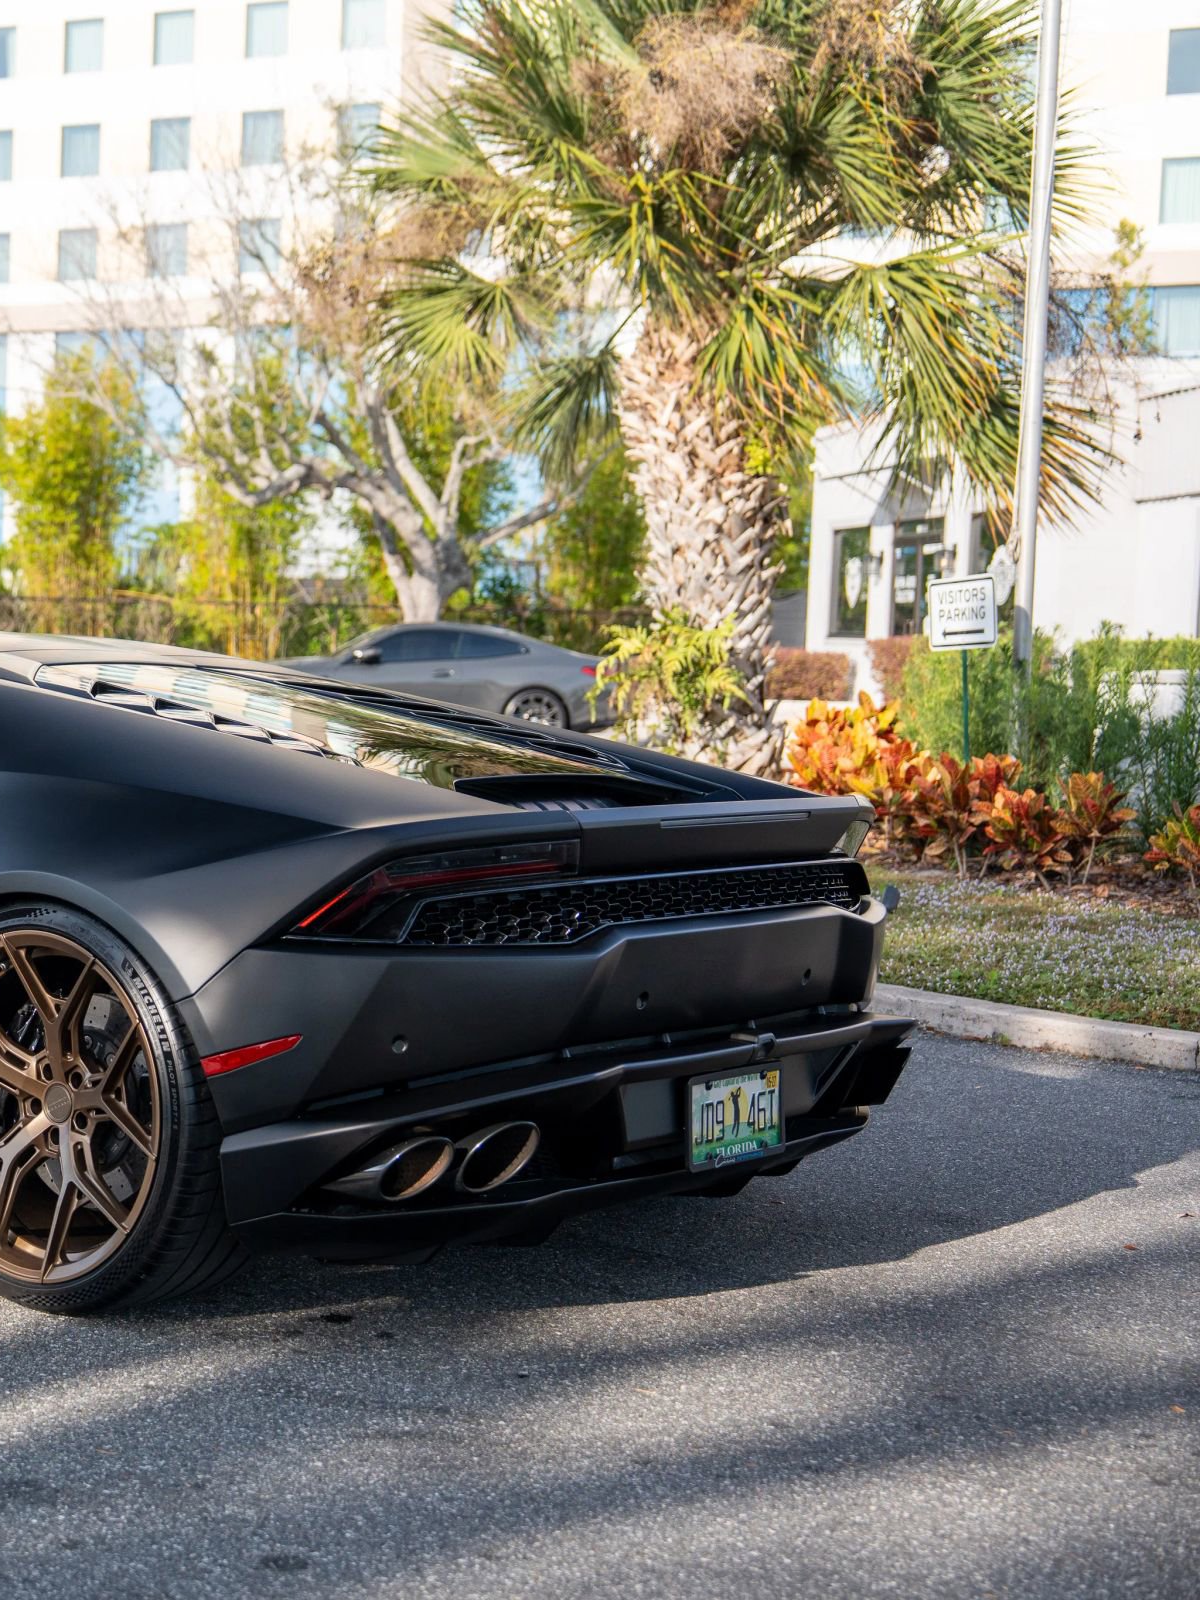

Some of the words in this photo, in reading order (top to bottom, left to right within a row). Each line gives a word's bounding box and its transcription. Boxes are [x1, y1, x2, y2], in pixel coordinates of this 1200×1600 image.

[937, 587, 987, 605] VISITORS
[938, 606, 987, 623] PARKING
[132, 977, 171, 1052] MICHELIN
[716, 1140, 757, 1158] FLORIDA
